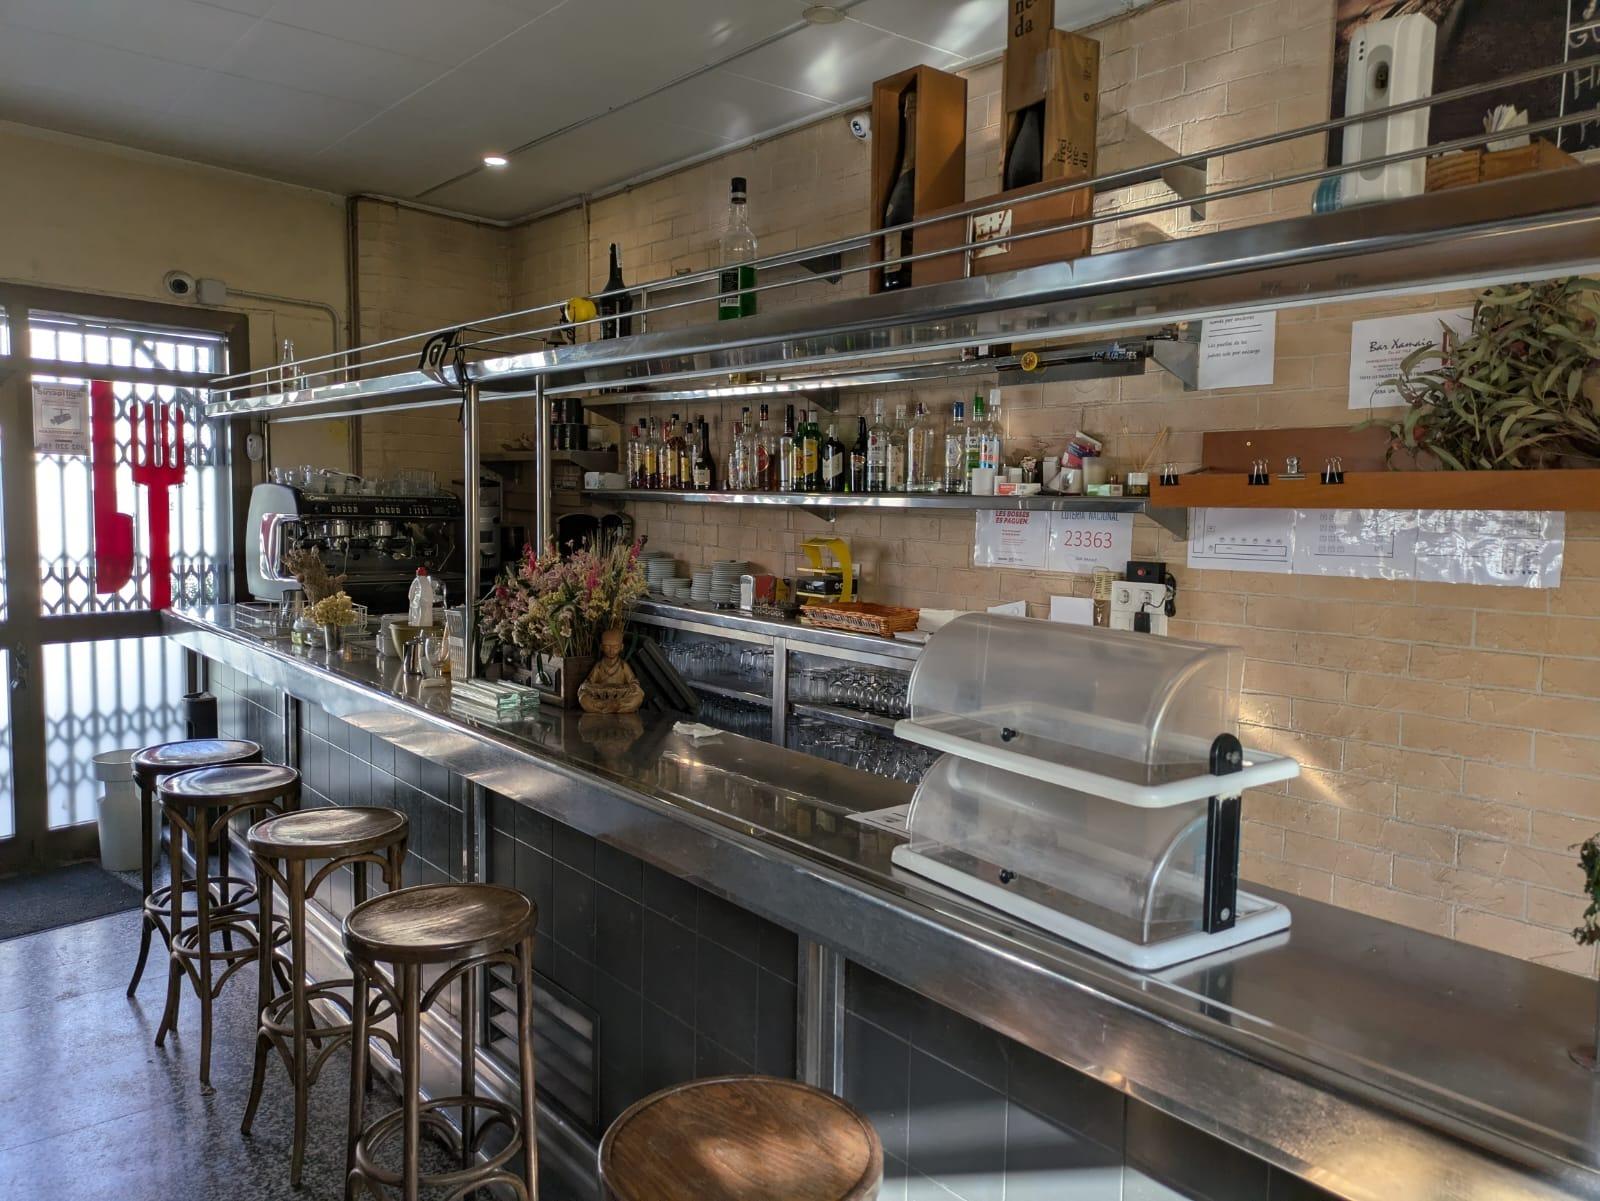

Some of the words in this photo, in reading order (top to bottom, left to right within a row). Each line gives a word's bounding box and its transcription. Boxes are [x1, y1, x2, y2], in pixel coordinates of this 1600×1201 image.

[1015, 15, 1033, 37] da
[1369, 341, 1388, 352] Bar
[1004, 517, 1028, 525] PAGUEN
[1064, 529, 1112, 549] 23363
